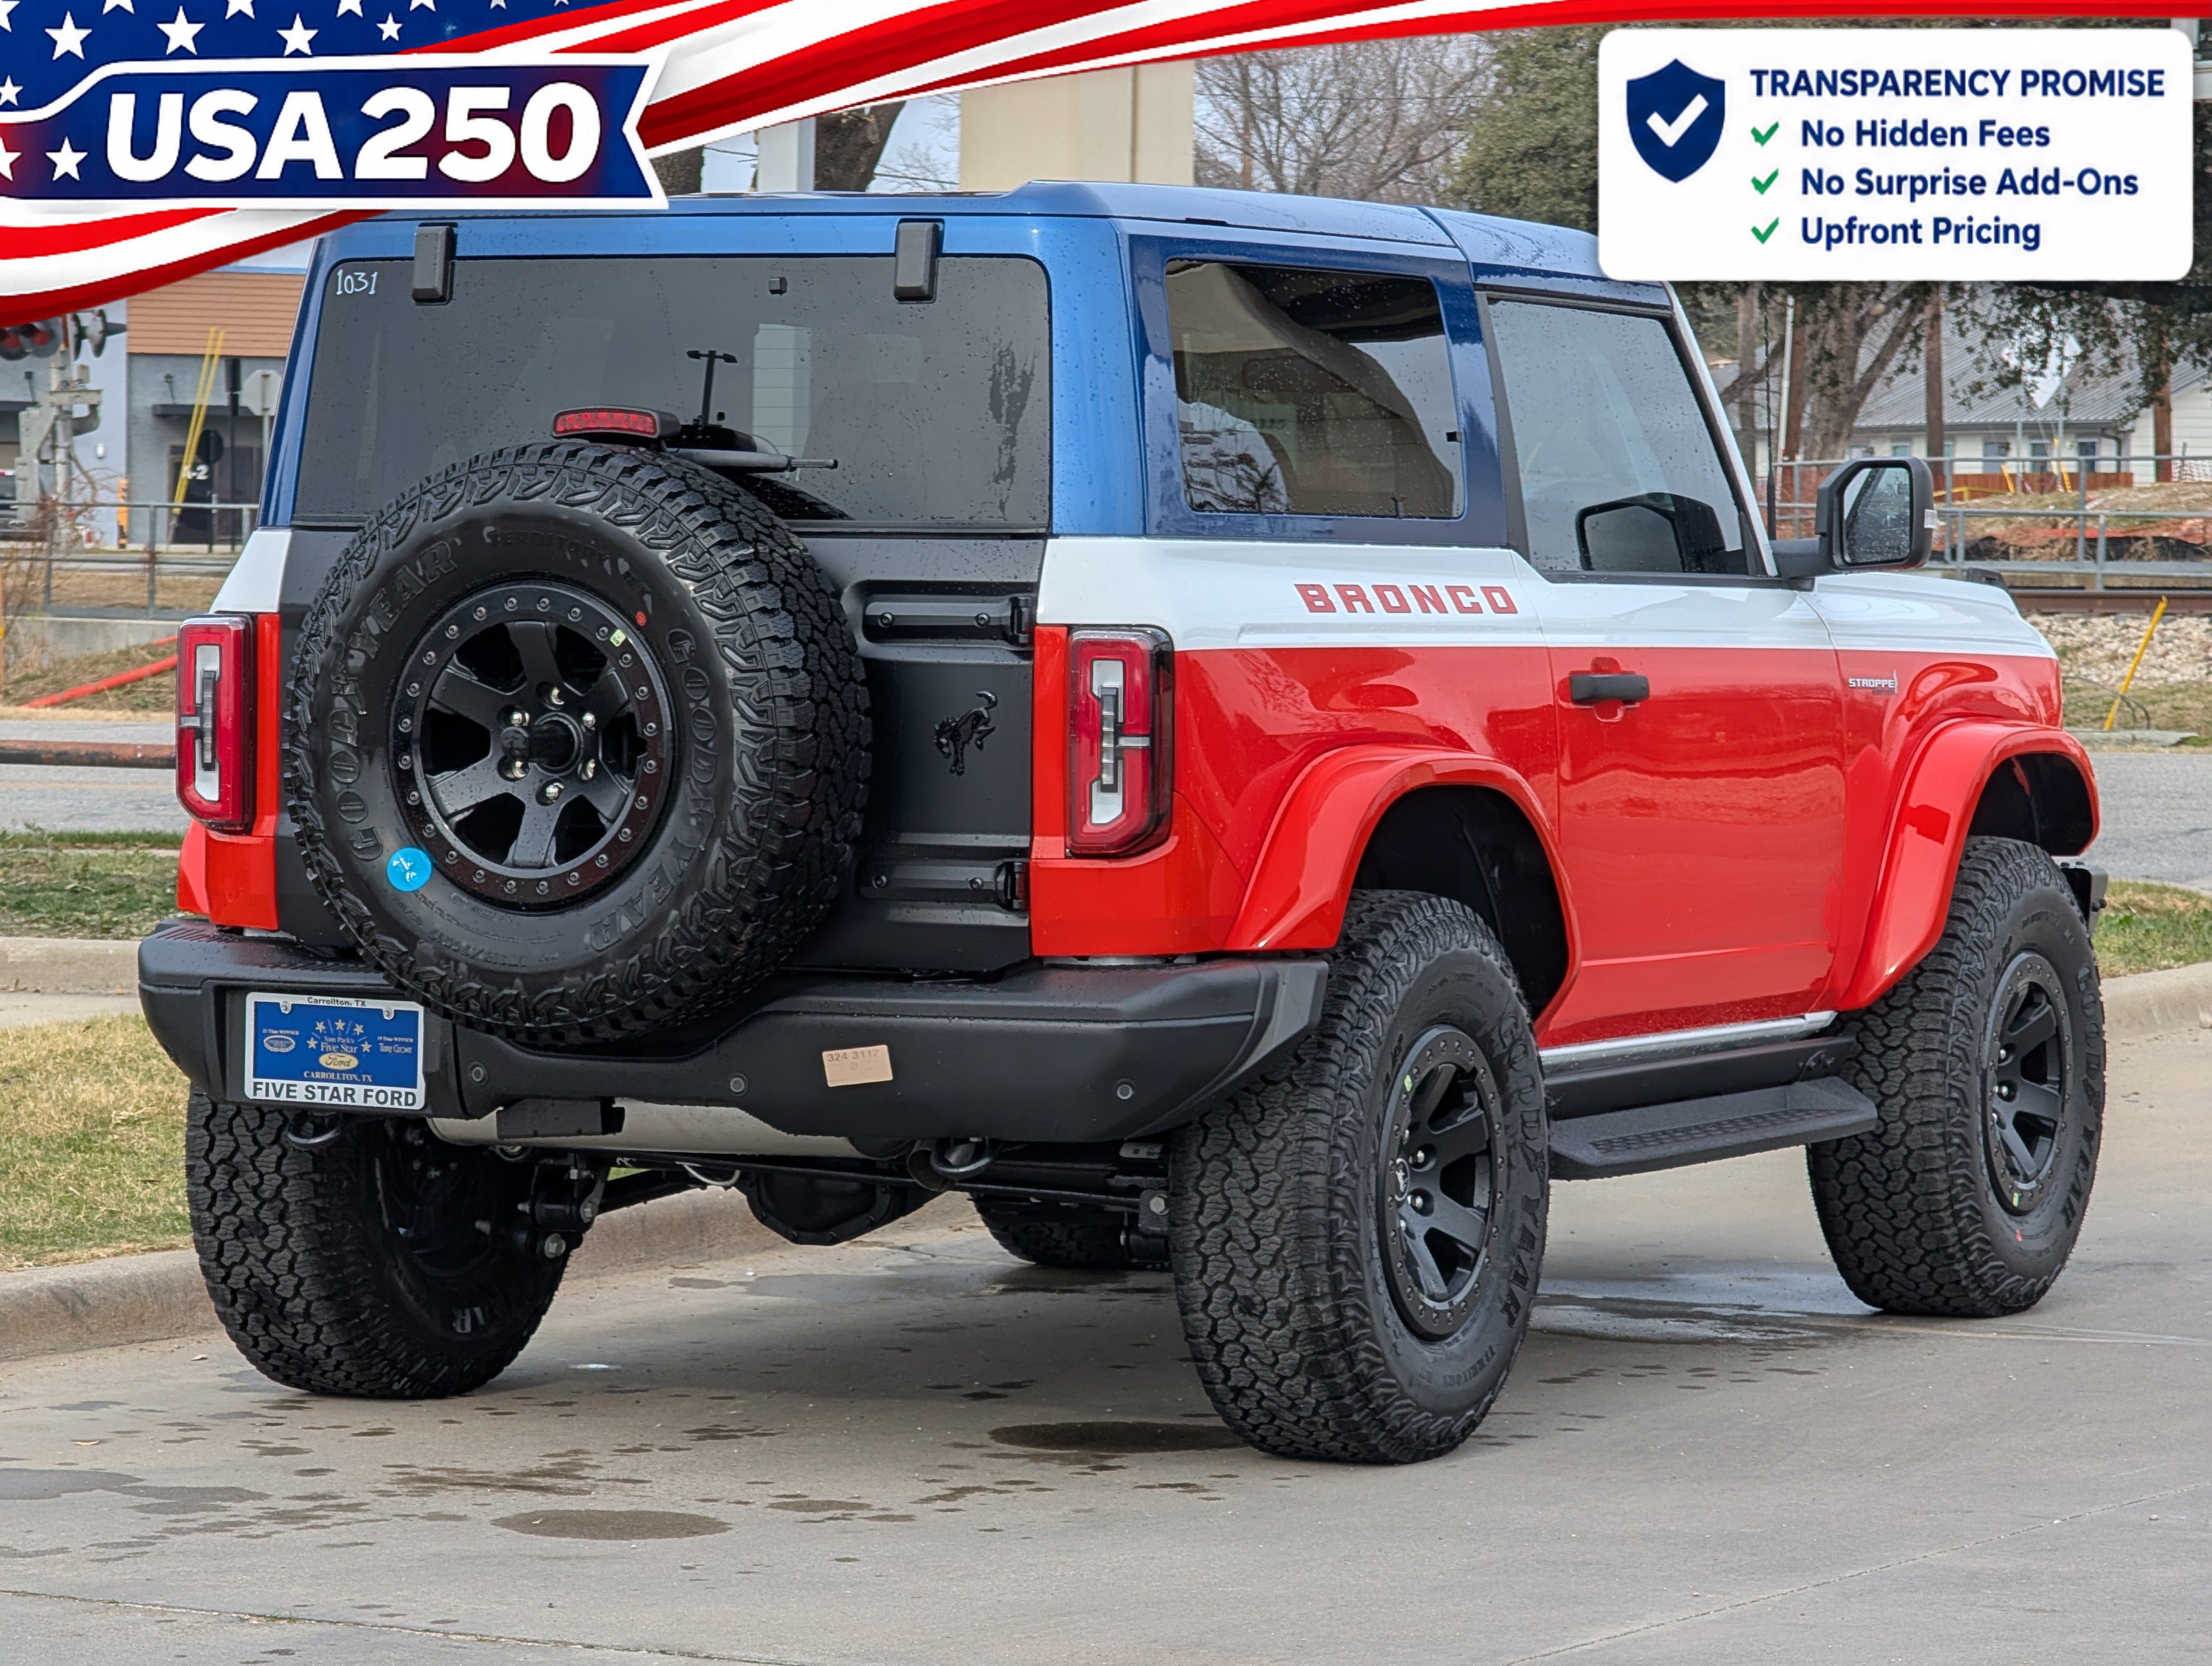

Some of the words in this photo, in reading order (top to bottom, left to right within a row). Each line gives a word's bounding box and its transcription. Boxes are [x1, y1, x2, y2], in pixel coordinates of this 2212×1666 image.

[336, 269, 378, 295] 1031
[1294, 584, 1518, 614] BRONCO
[1848, 678, 1895, 688] STROPPE
[307, 997, 352, 1007] Carrollton,
[320, 1042, 338, 1052] Five
[340, 1044, 358, 1054] Star
[325, 1054, 352, 1067] Ford
[827, 1052, 847, 1062] 324
[852, 1048, 879, 1060] 3112
[362, 1074, 372, 1082] TX
[252, 1081, 298, 1099] FIVE
[304, 1085, 356, 1104] STAR
[363, 1088, 417, 1107] FORD
